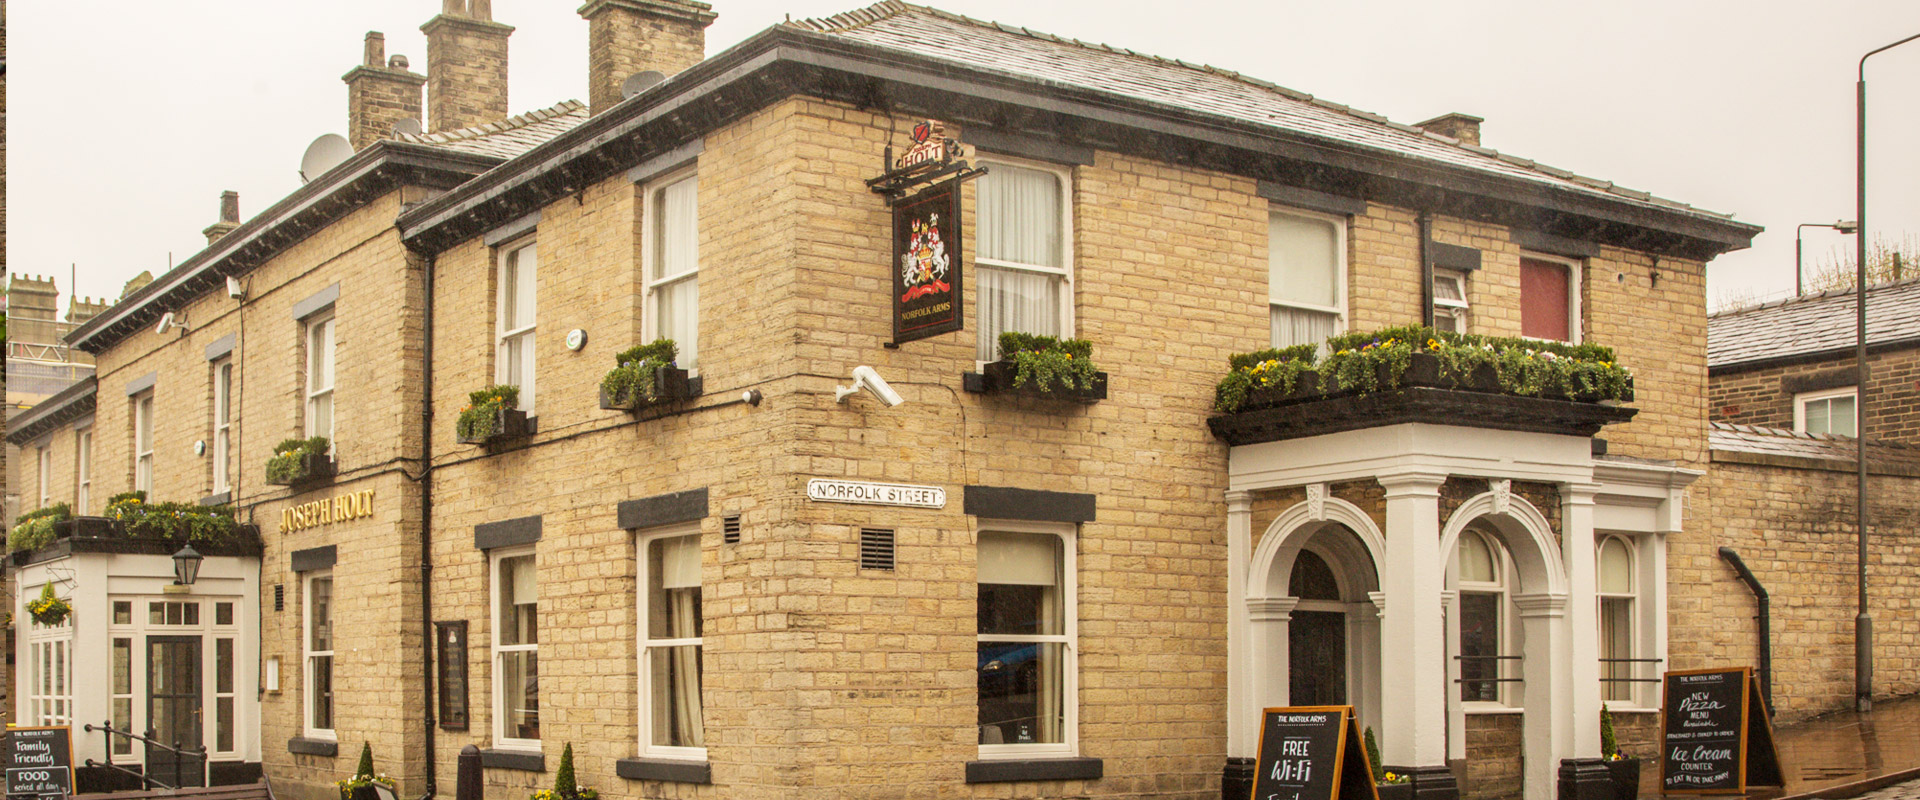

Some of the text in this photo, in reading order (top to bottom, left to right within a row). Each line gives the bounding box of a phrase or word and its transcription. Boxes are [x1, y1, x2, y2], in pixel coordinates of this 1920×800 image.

[904, 145, 942, 168] HOLT
[901, 302, 951, 320] NORFOLK ARMS
[817, 484, 937, 503] NORFOLK STREET
[280, 489, 375, 534] JOSEPH HOLT
[1691, 692, 1709, 700] NEW
[1678, 697, 1726, 712] Pizza
[1690, 711, 1709, 719] MENU
[15, 740, 50, 755] Family
[1282, 741, 1310, 756] FREE
[1671, 745, 1732, 761] Ice Cream
[14, 753, 54, 767] Friendly
[18, 771, 50, 781] FOOD
[1673, 774, 1685, 783] EAT
[14, 782, 59, 792] served all day
